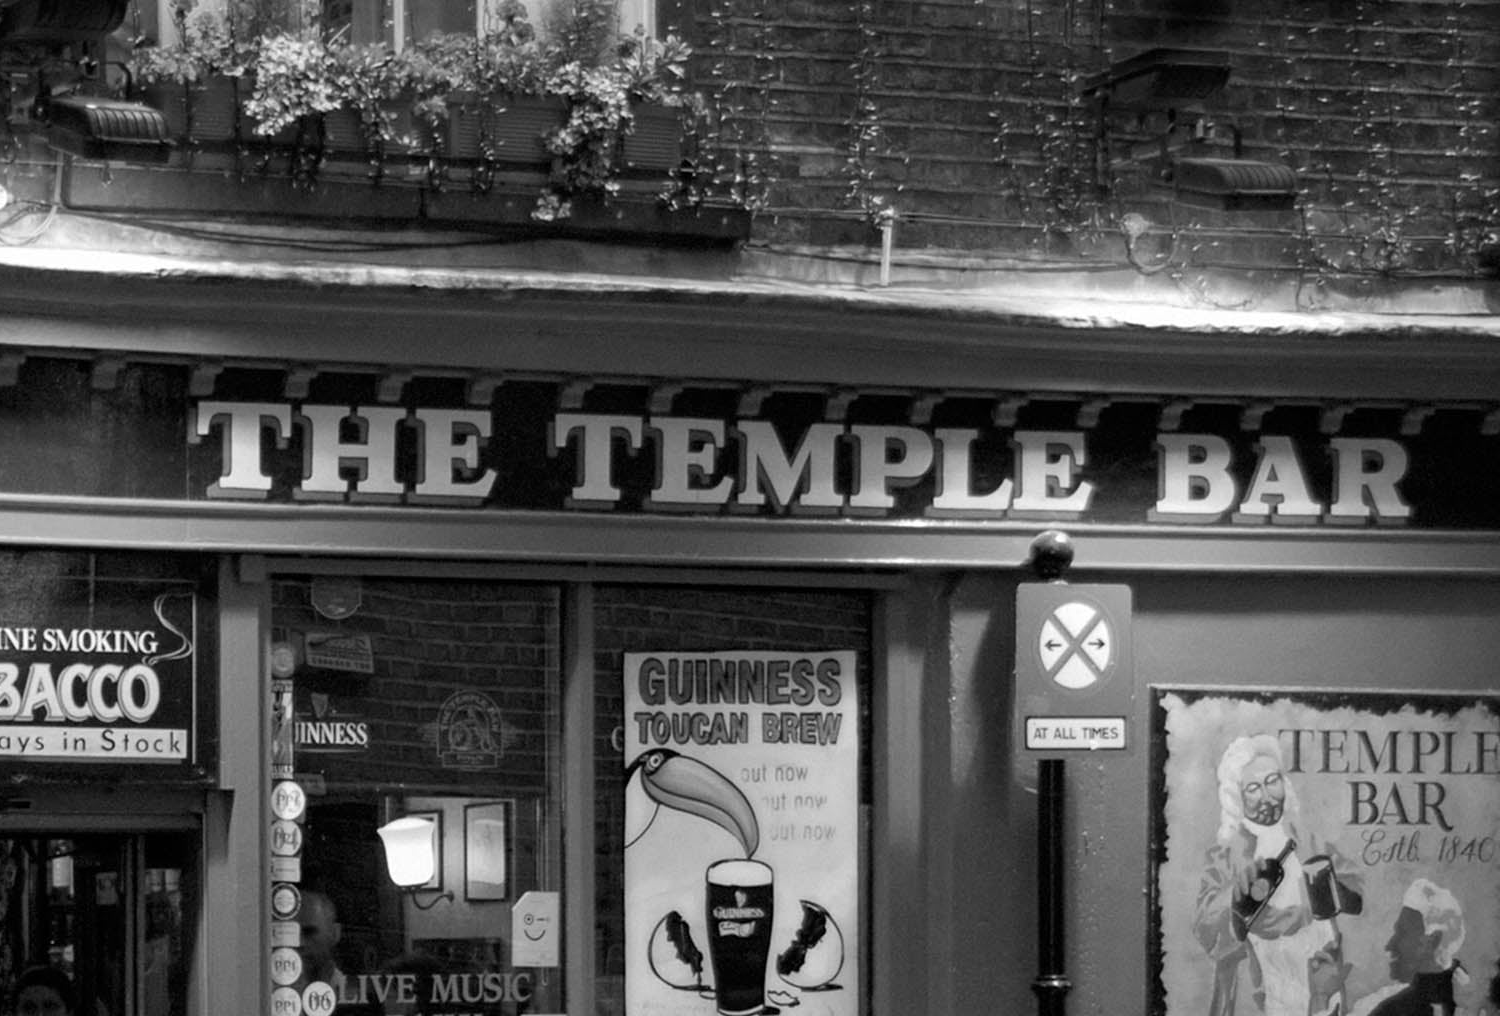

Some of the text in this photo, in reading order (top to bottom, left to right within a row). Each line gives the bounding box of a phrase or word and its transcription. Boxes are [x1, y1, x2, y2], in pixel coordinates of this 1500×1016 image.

[190, 402, 1411, 520] THE TEMPLE BAR
[43, 628, 159, 654] SMOKING
[638, 658, 842, 706] GUINNESS
[63, 732, 86, 751] in
[101, 729, 182, 754] Stock
[295, 721, 369, 746] INNESS
[634, 712, 748, 745] TOUCAN
[762, 712, 843, 745] BREW
[1033, 727, 1119, 740] AT ALL TIMES
[1278, 729, 1500, 775] TEMPLE
[741, 765, 808, 783] out now
[1346, 780, 1453, 832] BAR
[803, 825, 836, 841] now
[1438, 836, 1496, 864] 1840
[309, 991, 332, 1012] 06
[337, 973, 532, 1004] LIVE MUSIC
